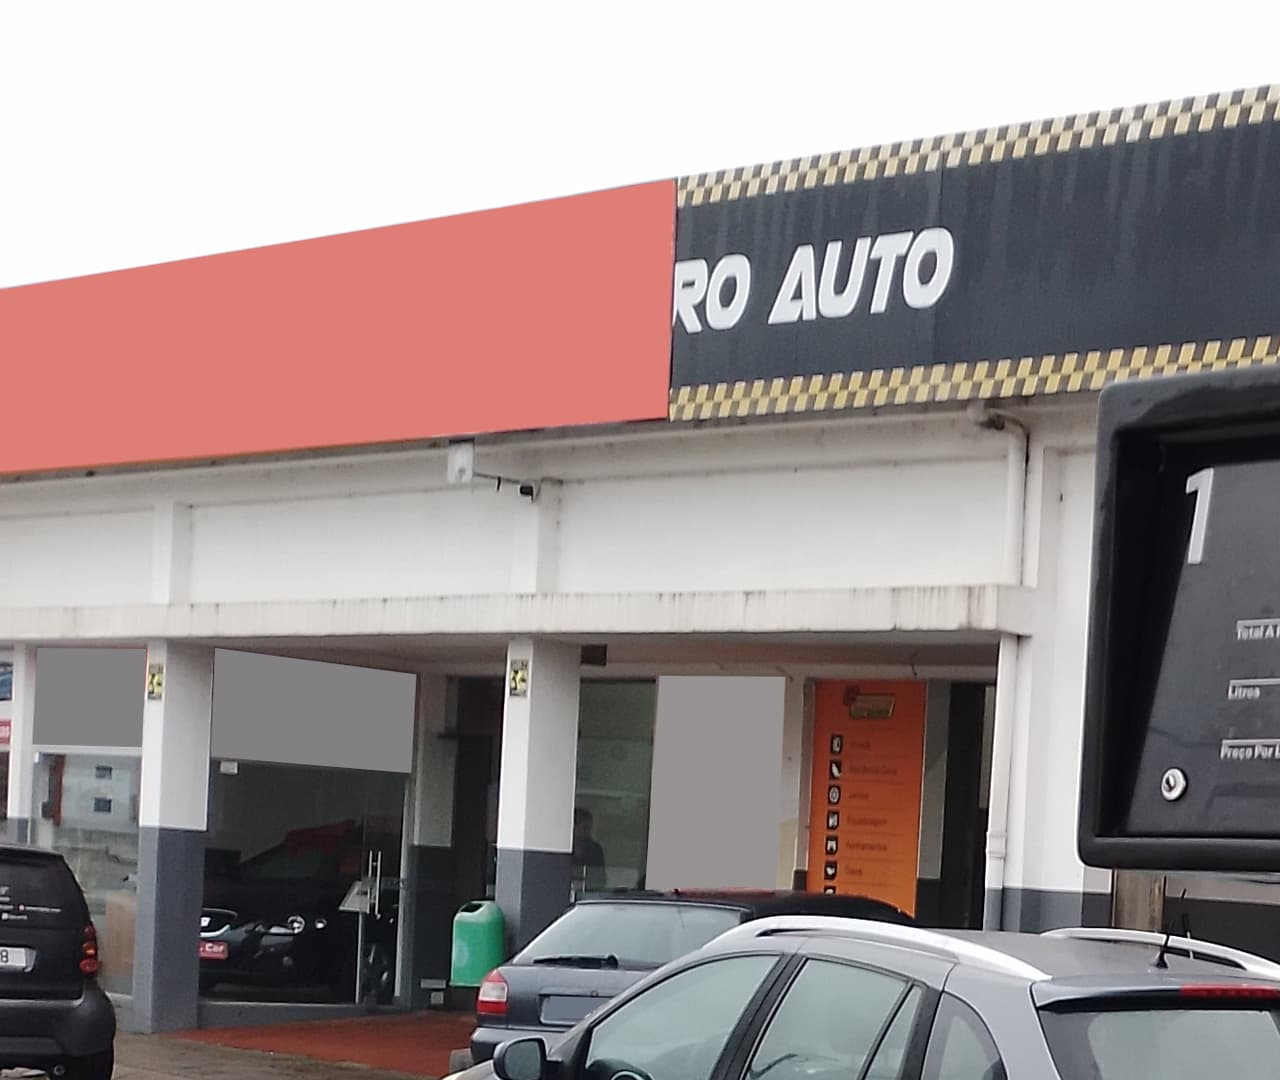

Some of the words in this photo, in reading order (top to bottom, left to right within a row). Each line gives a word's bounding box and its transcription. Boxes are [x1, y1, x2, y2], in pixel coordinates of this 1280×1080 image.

[768, 226, 955, 325] AUTO
[1186, 468, 1214, 564] 1
[1228, 685, 1262, 700] Litros
